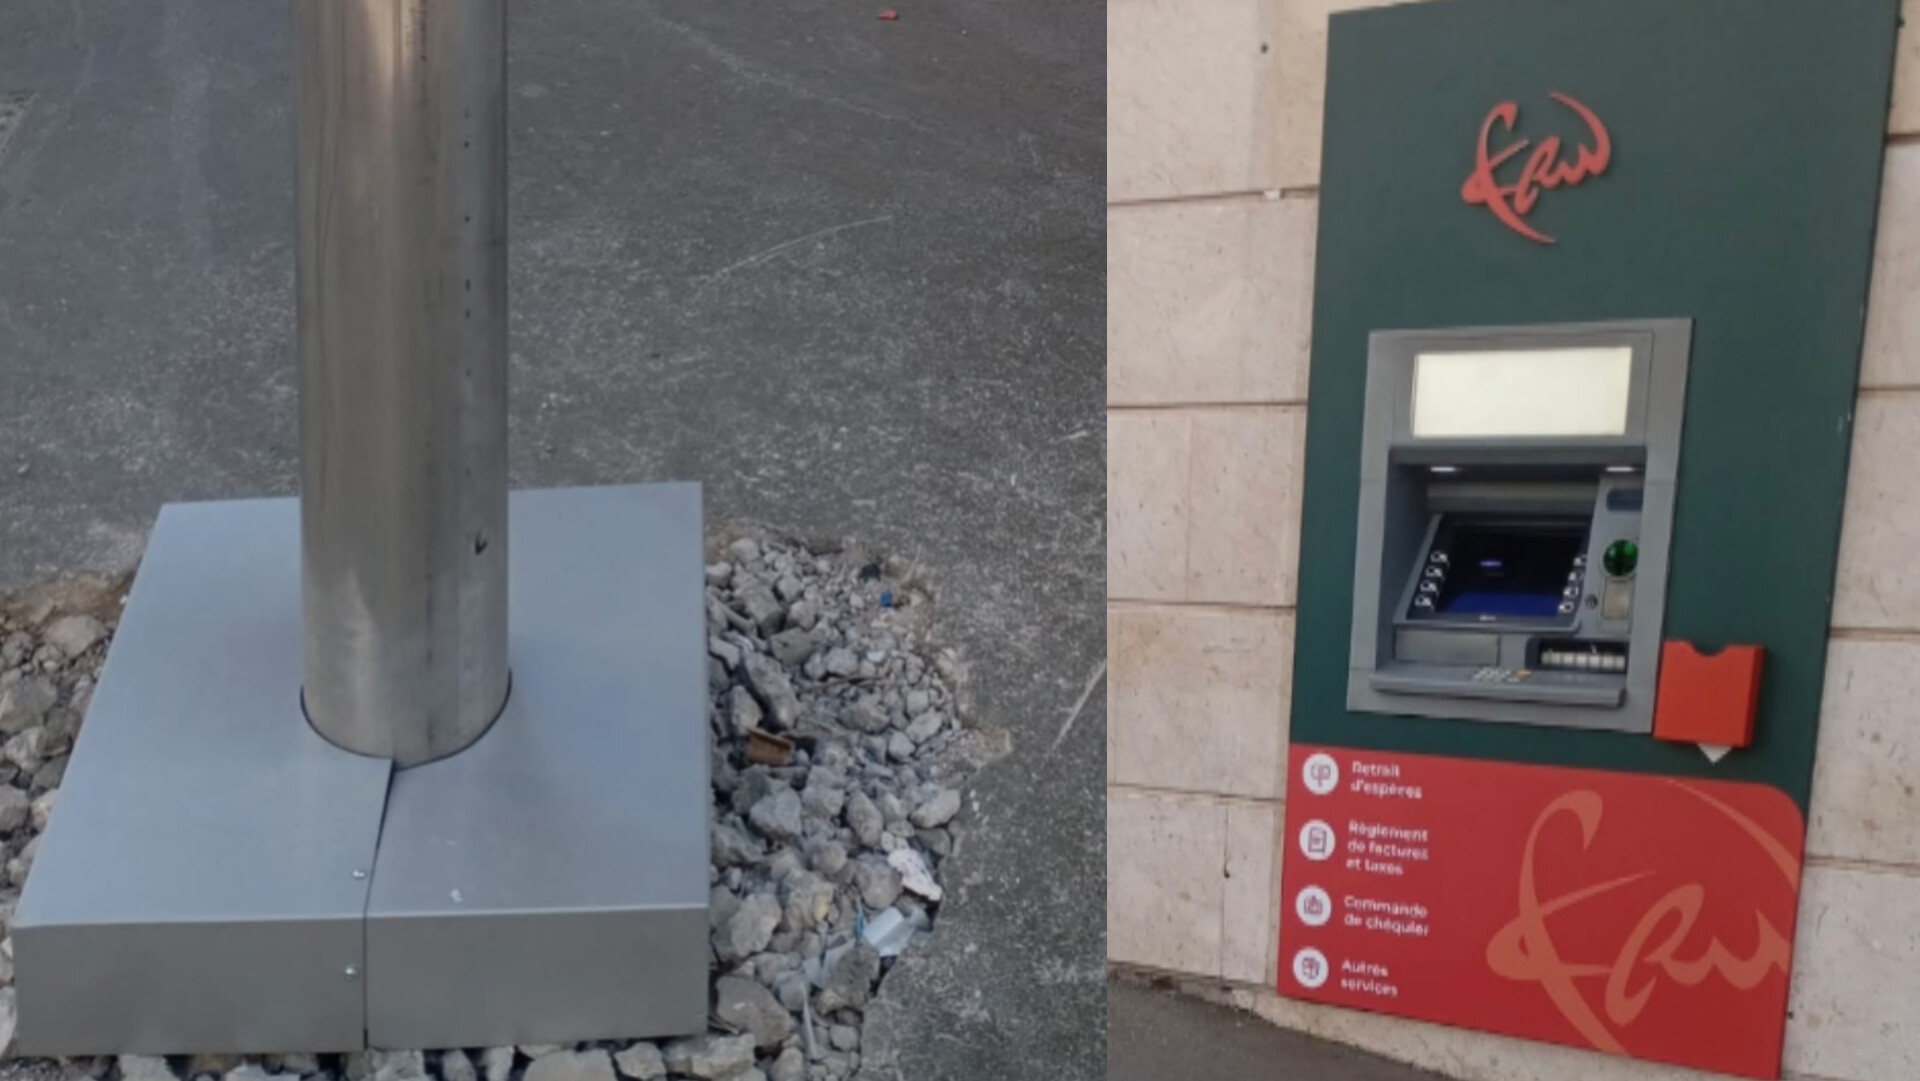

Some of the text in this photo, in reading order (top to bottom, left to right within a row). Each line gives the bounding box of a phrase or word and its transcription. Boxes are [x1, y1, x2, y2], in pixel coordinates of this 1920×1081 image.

[1344, 895, 1427, 918] Commande
[1342, 959, 1388, 977] Autres
[1340, 979, 1398, 998] services
